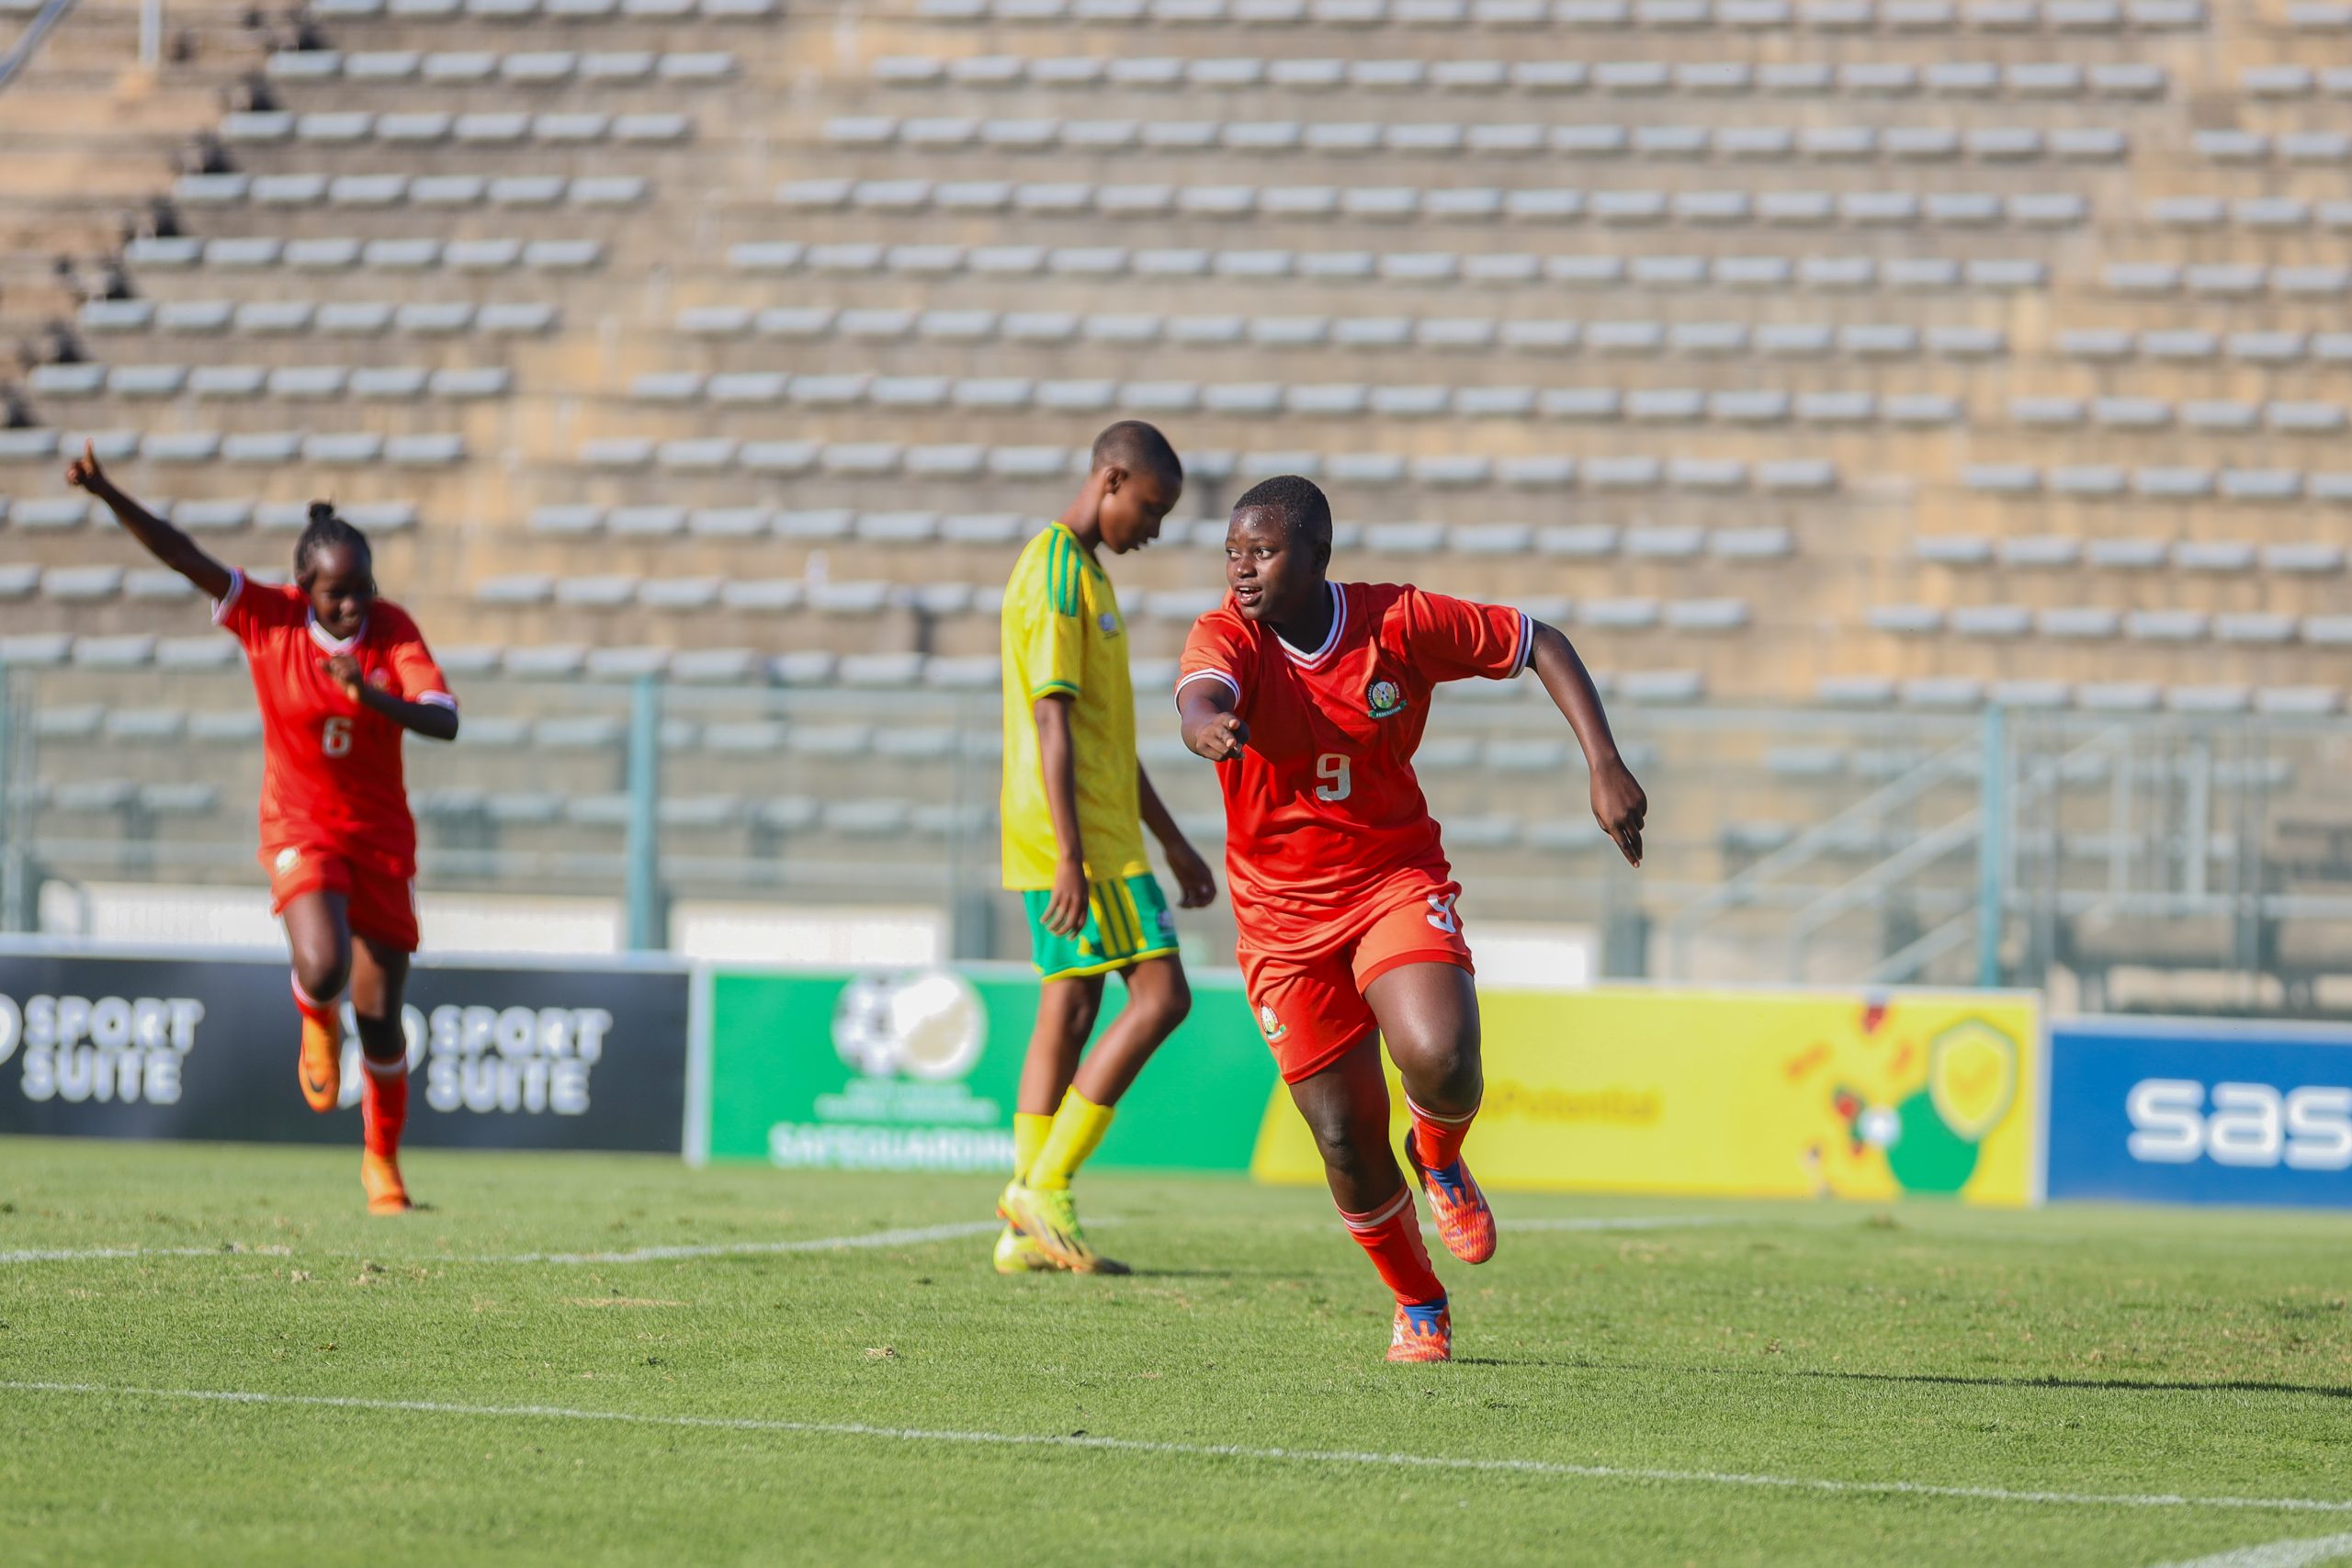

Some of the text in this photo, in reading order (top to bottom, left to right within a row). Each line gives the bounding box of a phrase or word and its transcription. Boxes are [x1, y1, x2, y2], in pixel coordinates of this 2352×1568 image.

[322, 716, 353, 758] 6
[1316, 753, 1351, 802] 9
[24, 994, 205, 1055] SPORT
[428, 1004, 613, 1065] SPORT
[20, 1043, 183, 1104] SUITE
[425, 1055, 591, 1114] SUITE
[768, 1121, 1015, 1172] SAFEGUARDIN
[2126, 1077, 2352, 1171] sas
